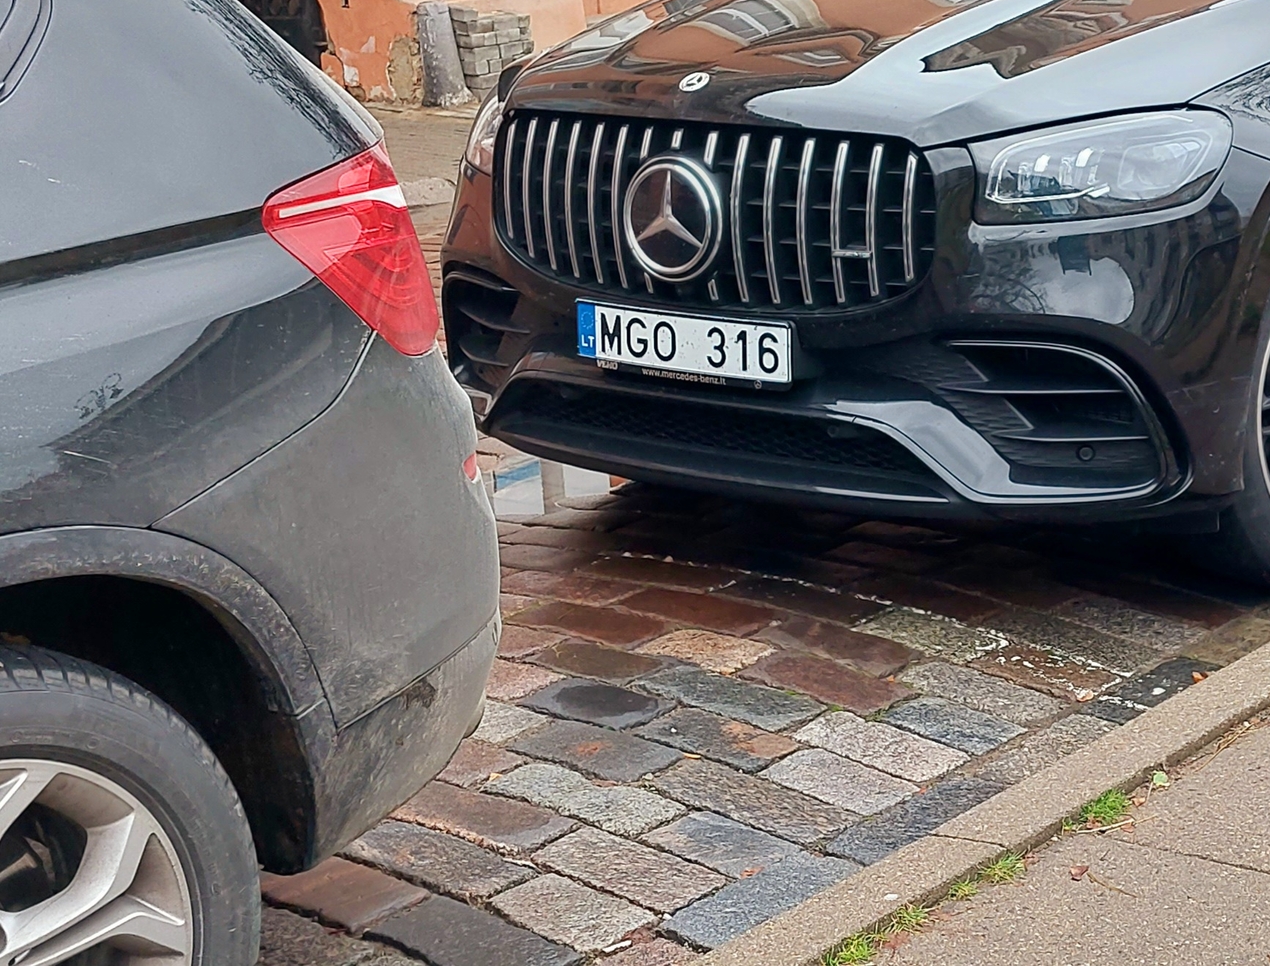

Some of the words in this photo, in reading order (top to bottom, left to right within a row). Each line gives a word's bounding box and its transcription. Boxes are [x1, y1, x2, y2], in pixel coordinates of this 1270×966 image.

[581, 334, 595, 348] LT
[600, 312, 676, 362] MGO
[706, 326, 779, 374] 316
